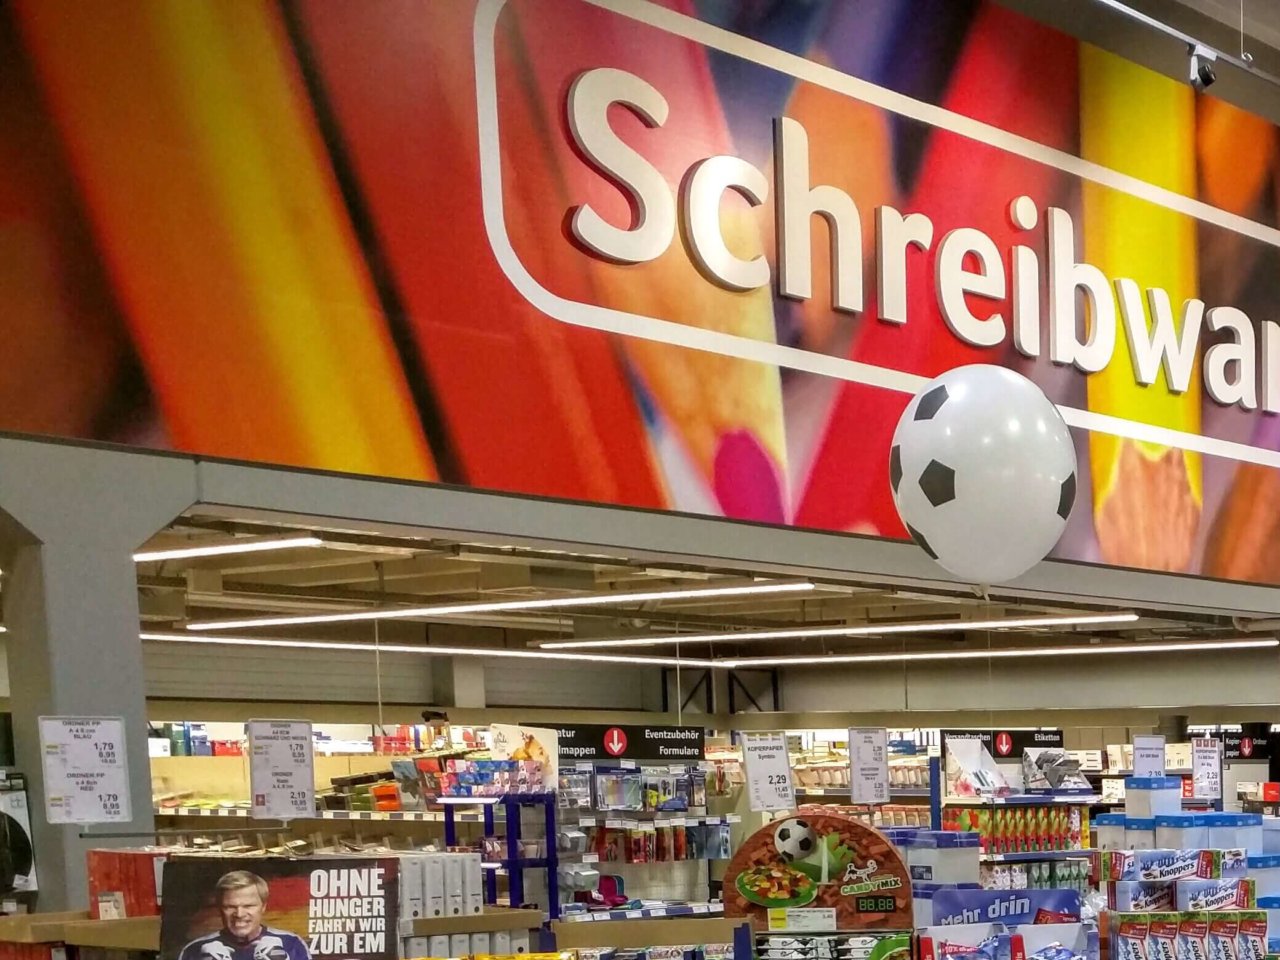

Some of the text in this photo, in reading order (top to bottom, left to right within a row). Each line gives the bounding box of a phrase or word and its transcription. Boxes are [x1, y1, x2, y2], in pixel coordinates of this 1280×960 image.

[645, 729, 700, 739] Eventzubehör
[1034, 733, 1061, 741] Etiketten
[558, 746, 596, 757] lmappen
[659, 746, 700, 755] Formulare
[768, 774, 787, 786] 2,29
[1159, 861, 1195, 878] Knoppers
[310, 868, 385, 897] OHNE
[841, 878, 901, 895] CANDY MIX
[308, 897, 385, 918] HUNGER
[988, 894, 1030, 919] drin
[1204, 890, 1235, 908] Knoppers
[359, 918, 386, 931] WIR
[308, 932, 386, 955] ZUR EM
